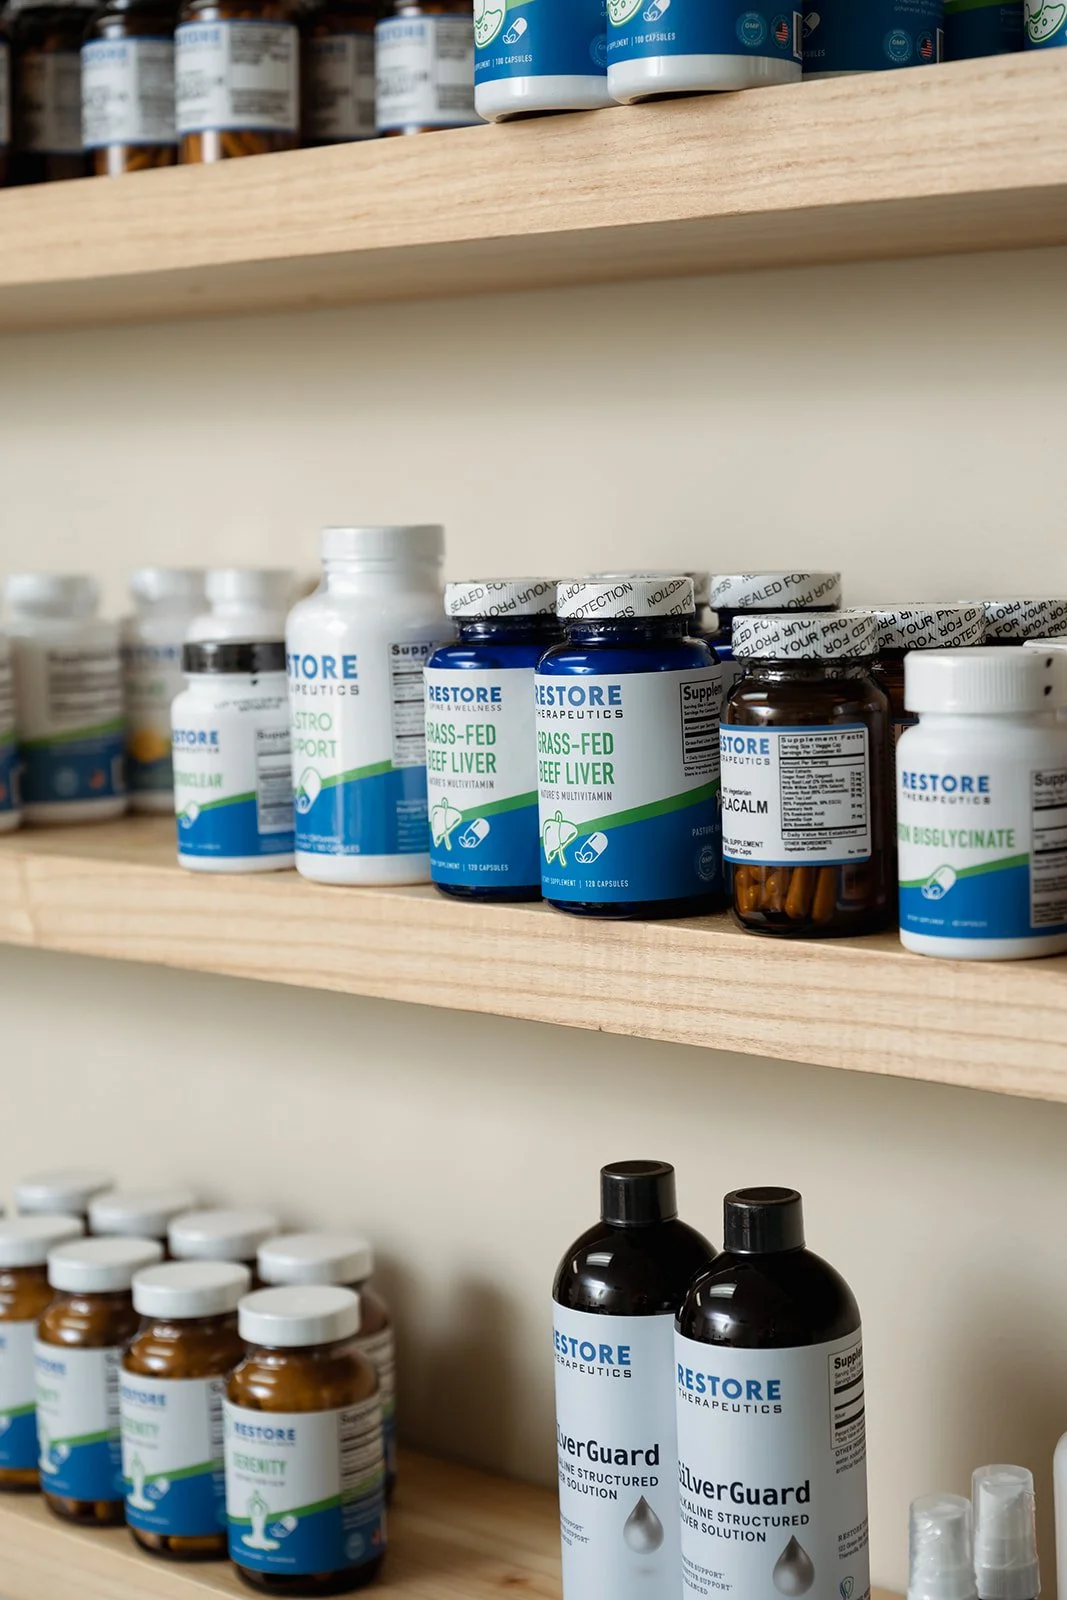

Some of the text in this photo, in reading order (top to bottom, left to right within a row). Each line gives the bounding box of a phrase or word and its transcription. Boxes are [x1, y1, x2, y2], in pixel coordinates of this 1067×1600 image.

[635, 37, 645, 46] 100
[646, 32, 676, 43] CAPSULES
[495, 54, 533, 65] 100 CAPSULES
[450, 587, 484, 614] SEALED
[738, 581, 783, 609] SEALED
[1021, 602, 1048, 621] YOUR
[897, 615, 934, 638] YOUR
[938, 617, 963, 637] FOR
[1021, 616, 1049, 636] YOUR
[780, 632, 820, 655] YOUR
[823, 632, 851, 654] FOR
[429, 686, 503, 703] RESTORE
[454, 704, 503, 712] WELLNESS
[538, 732, 615, 756] GRASS-FED
[781, 735, 838, 744] Supplement
[452, 752, 497, 773] LIVER
[540, 760, 615, 785] BEEF LIVER
[448, 779, 495, 789] MULTIVITAMIN
[902, 771, 990, 794] RESTORE
[561, 790, 613, 801] MULTIVITAMIN
[903, 792, 991, 805] THERAPEUTICS
[913, 825, 1016, 849] BISGLYCINATE
[468, 863, 478, 871] 120
[479, 864, 509, 872] CAPSULES
[550, 878, 629, 888] SUPPLEMENT 120 CAPSULES
[554, 1330, 631, 1366] ESTORE
[677, 1362, 781, 1401] RESTORE
[678, 1387, 783, 1415] THERAPEUTICS
[233, 1421, 297, 1442] RESTORE
[557, 1424, 660, 1467] lverGuard
[233, 1453, 287, 1477] SERENITY
[577, 1467, 659, 1487] STRUCTURED
[566, 1477, 618, 1500] SOLUTION
[717, 1511, 810, 1528] STRUCTURED
[701, 1522, 767, 1543] SOLUTION
